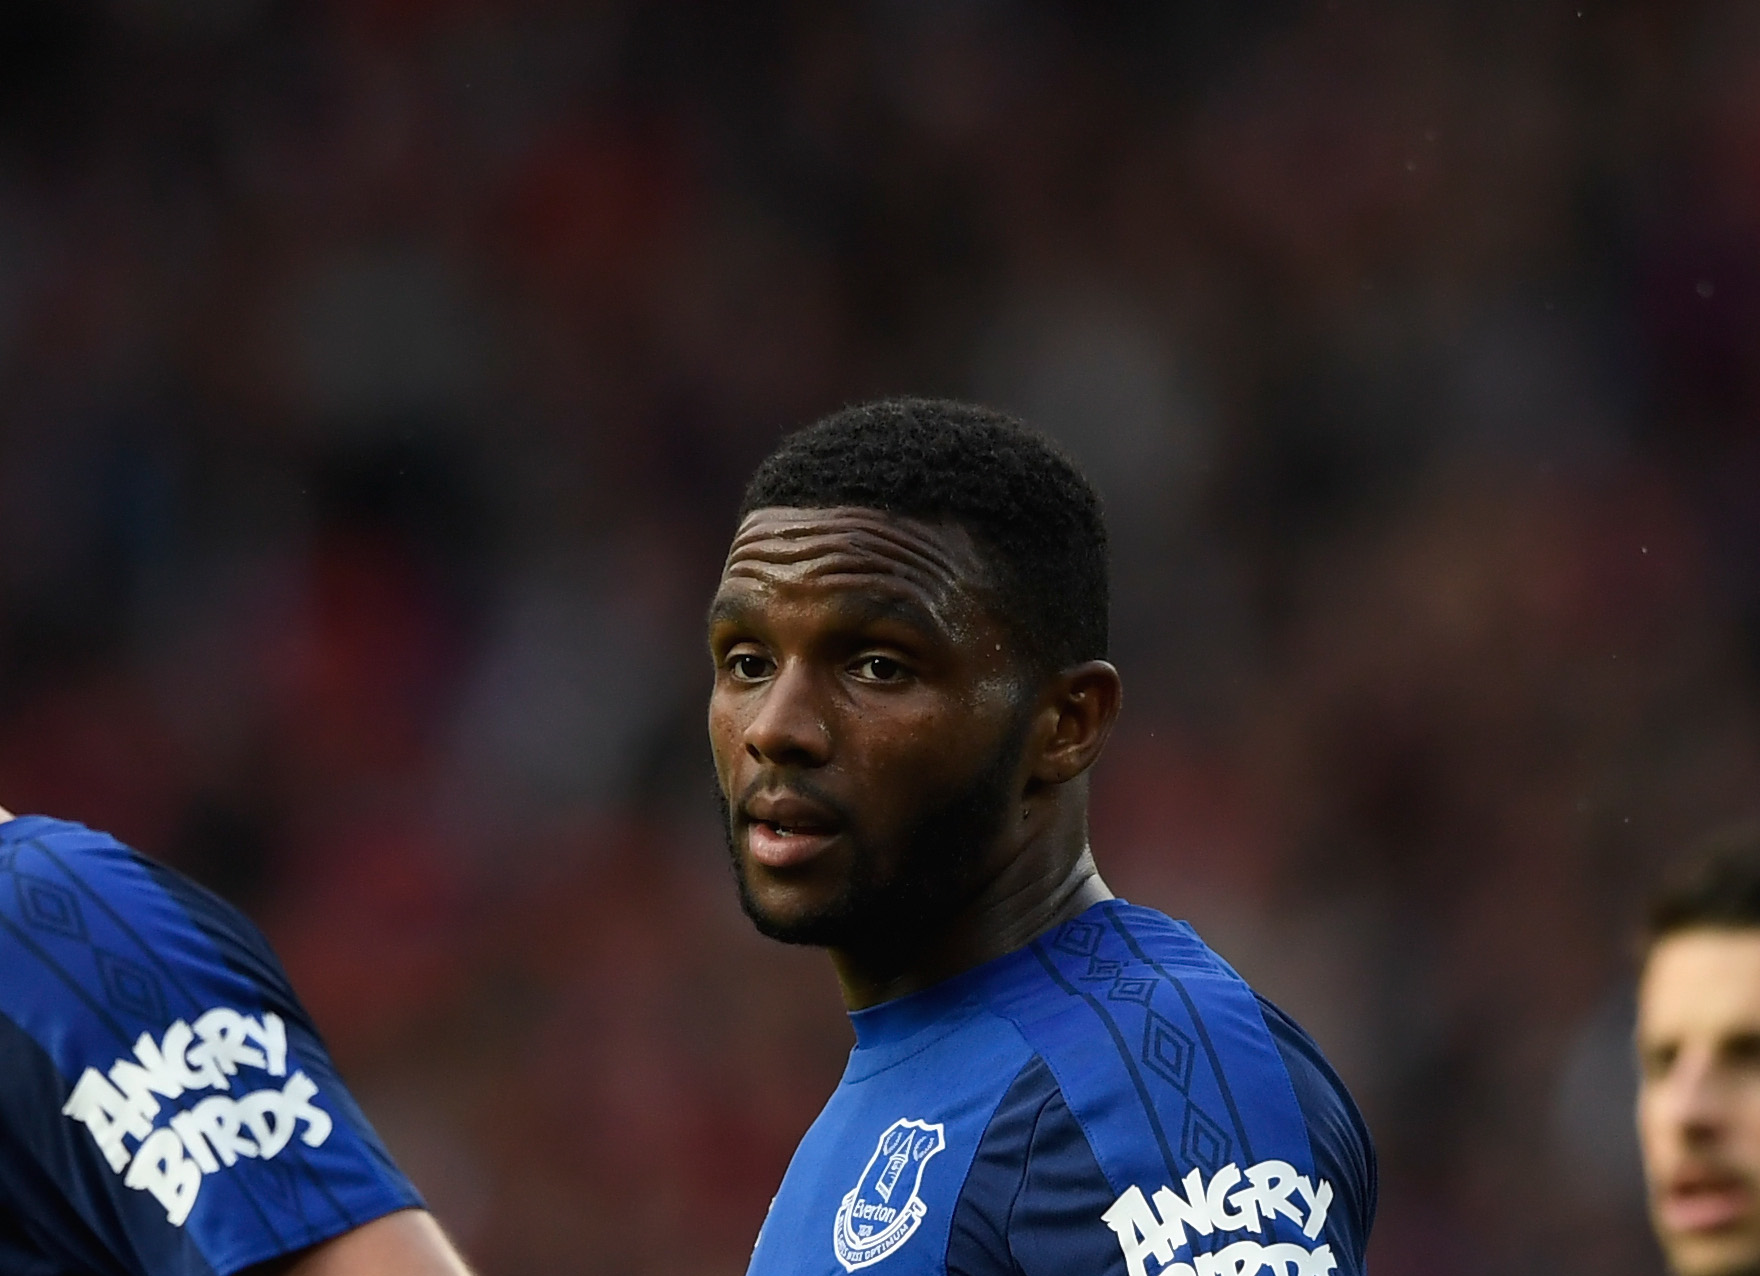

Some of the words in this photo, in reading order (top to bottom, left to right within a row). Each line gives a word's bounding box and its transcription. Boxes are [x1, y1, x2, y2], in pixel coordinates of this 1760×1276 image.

[61, 1007, 287, 1174] ANGRY
[124, 1069, 332, 1227] BIRDS
[852, 1198, 897, 1224] Everton
